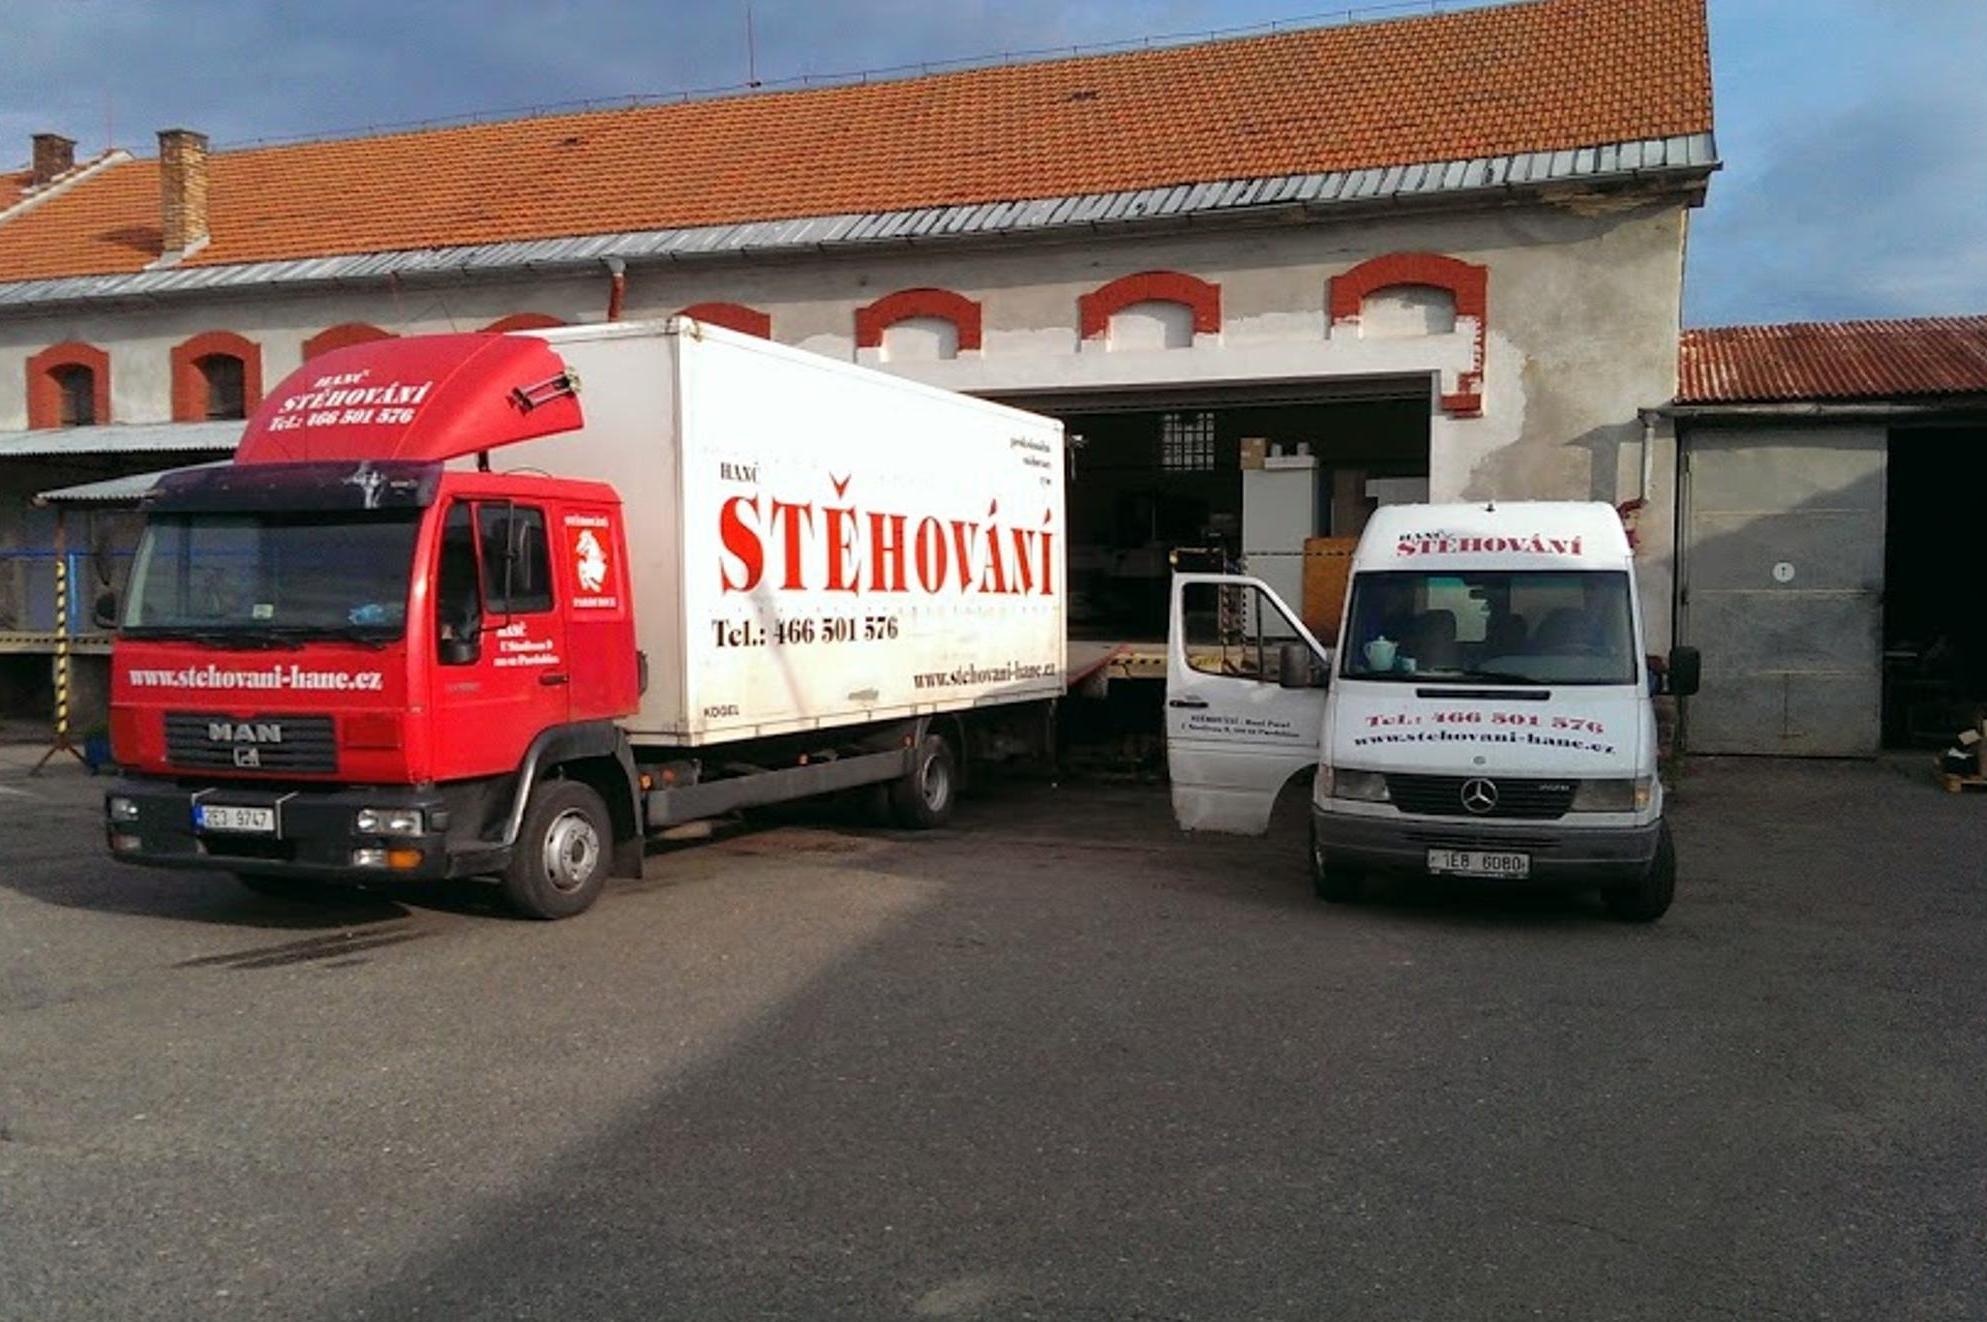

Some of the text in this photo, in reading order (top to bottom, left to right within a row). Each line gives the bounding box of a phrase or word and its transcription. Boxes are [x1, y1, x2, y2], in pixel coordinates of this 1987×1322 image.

[278, 381, 433, 414] STĚHOVÁNÍ
[307, 410, 339, 427] 466
[339, 409, 374, 425] 501
[376, 408, 415, 425] 576
[719, 472, 1054, 597] STĚHOVÁNÍ
[1397, 533, 1582, 556] STĚHOVÁNÍ
[712, 616, 899, 647] Tel.: 466 501 576
[208, 723, 282, 743] MAN
[1431, 712, 1481, 725] 466
[1491, 713, 1541, 726] 501
[1551, 716, 1605, 735] 576
